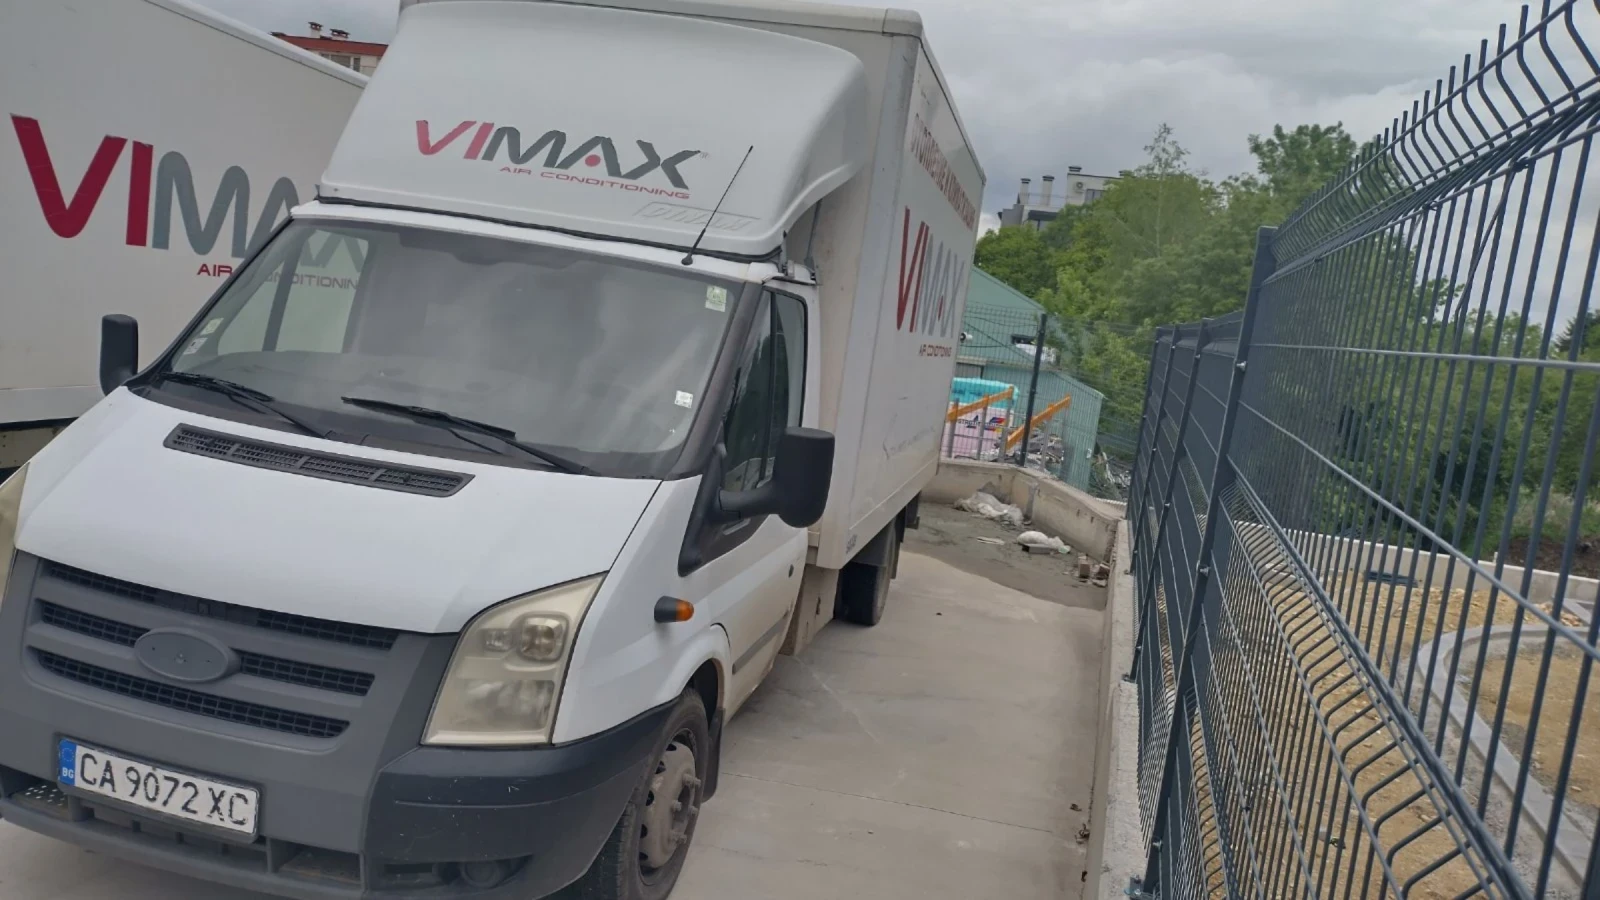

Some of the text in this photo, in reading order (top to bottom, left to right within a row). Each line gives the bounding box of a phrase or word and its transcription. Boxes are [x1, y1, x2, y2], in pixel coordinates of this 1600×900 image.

[416, 119, 700, 190] VIMAX
[500, 166, 691, 200] AIR CONDITIONING
[196, 263, 233, 277] AIR
[896, 205, 966, 339] VIMAX
[61, 767, 74, 779] BG
